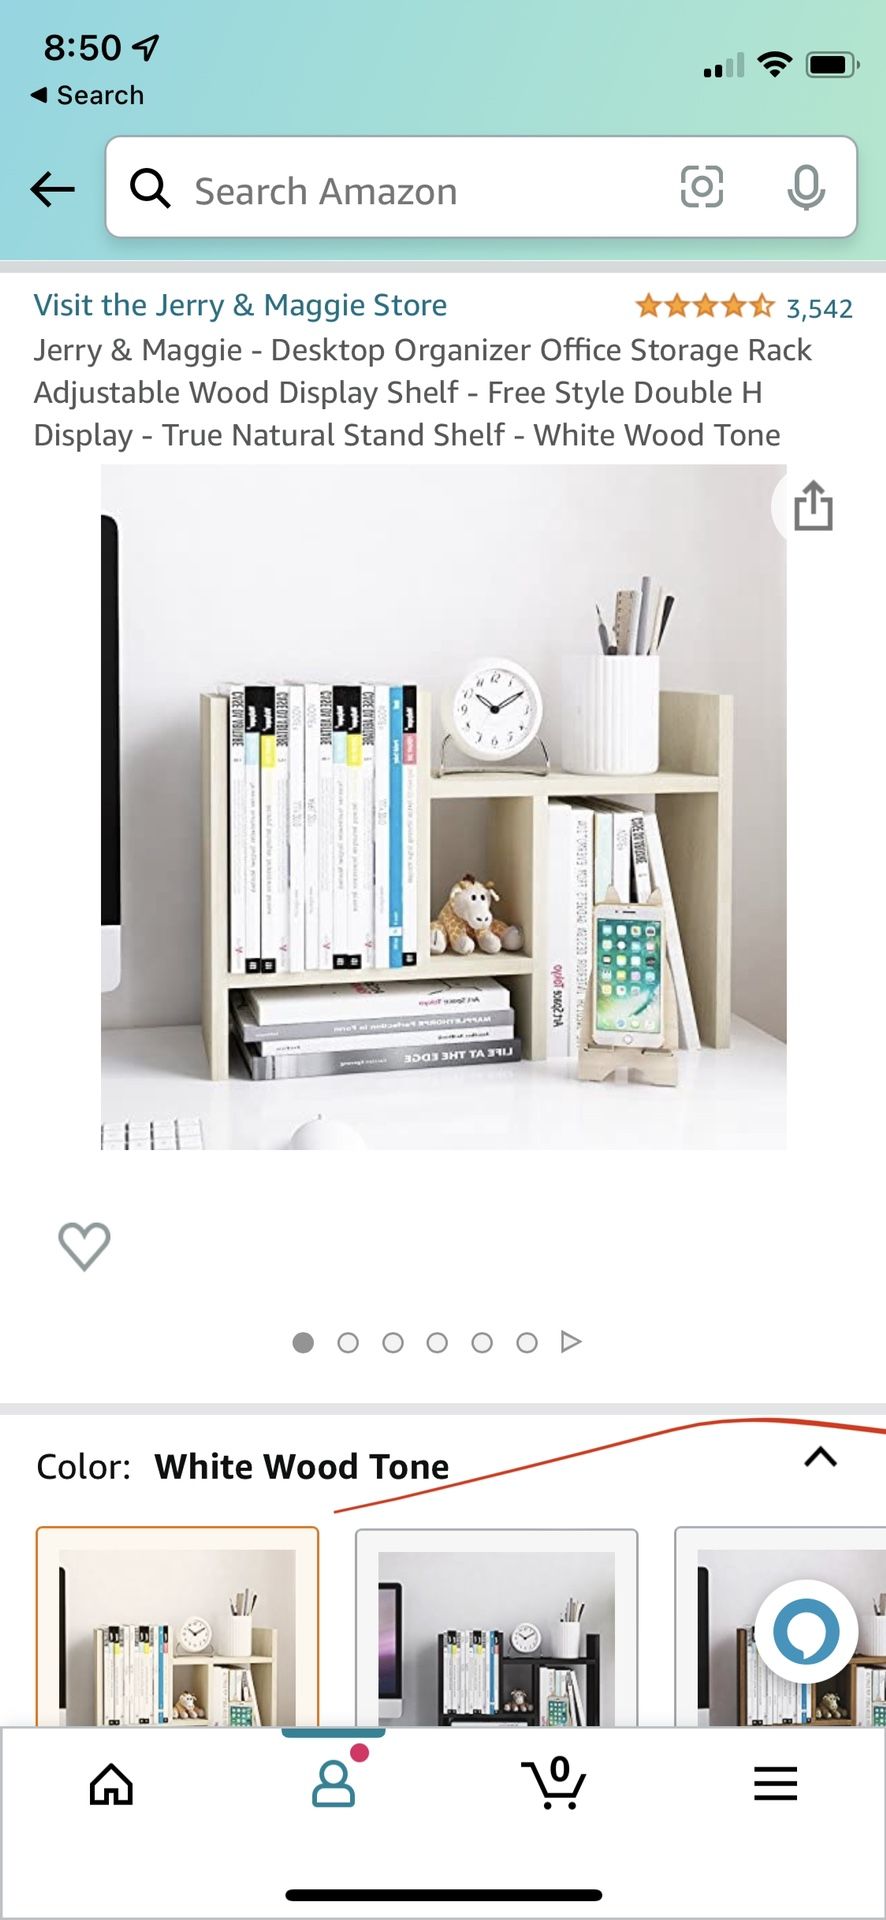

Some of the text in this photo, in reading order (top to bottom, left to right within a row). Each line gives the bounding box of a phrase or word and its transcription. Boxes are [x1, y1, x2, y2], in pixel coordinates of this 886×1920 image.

[45, 34, 121, 61] 8:50
[58, 85, 143, 105] Search
[196, 176, 456, 205] Search Amazon
[34, 292, 447, 322] Visit the Jerry & Maggie Store
[787, 299, 852, 322] 3,542
[34, 339, 102, 367] Jerry
[112, 338, 132, 361] &
[144, 338, 241, 367] Maggie
[273, 337, 384, 367] Desktop
[395, 338, 531, 367] Organizer
[541, 337, 621, 361] Office
[632, 338, 738, 367] Storage
[750, 337, 812, 361] Rack
[34, 380, 179, 410] Adjustable
[189, 380, 268, 403] Wood
[281, 380, 378, 410] Display
[388, 380, 459, 404] Shelf
[490, 381, 545, 403] Free
[556, 380, 624, 410] Style
[635, 380, 732, 403] Double
[743, 381, 761, 403] H
[35, 422, 133, 452] Display
[162, 424, 222, 446] True
[233, 422, 334, 446] Natural
[345, 422, 423, 446] Stand
[434, 422, 505, 446] Shelf
[534, 423, 614, 446] White
[624, 422, 703, 446] Wood
[714, 424, 780, 446] Tone
[38, 1452, 448, 1480] Color: White Wood Tone
[550, 1756, 569, 1782] 0
